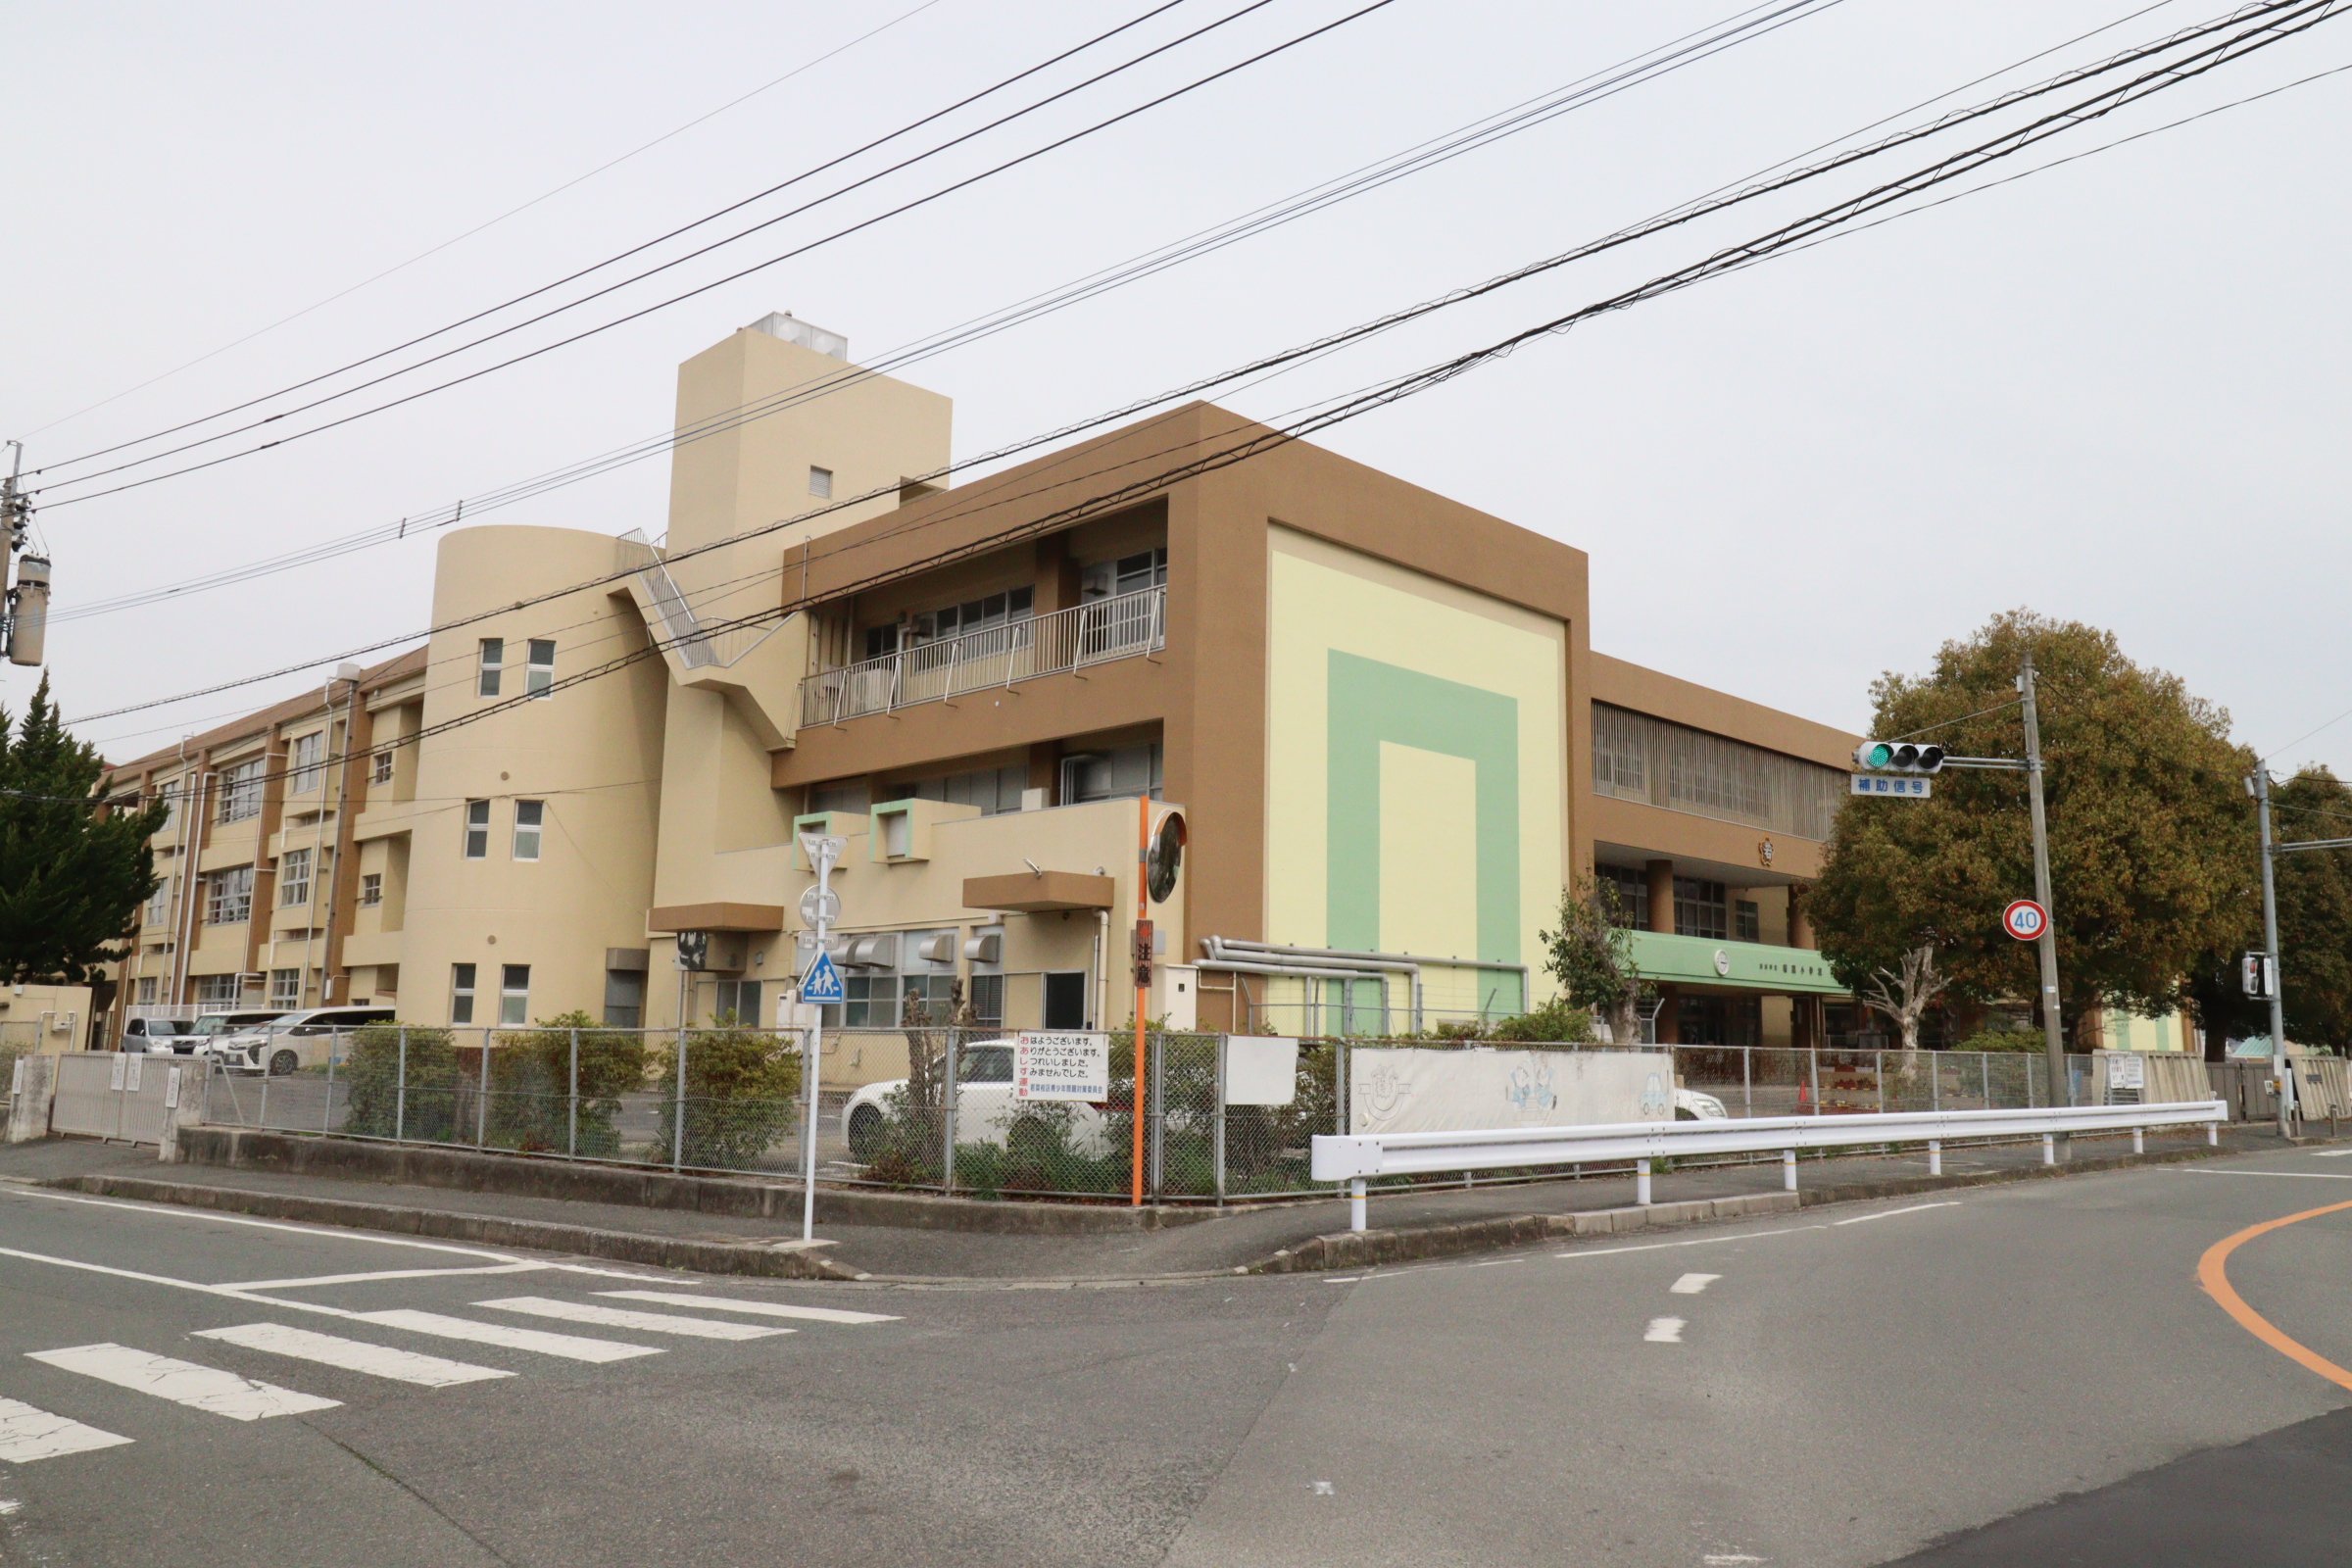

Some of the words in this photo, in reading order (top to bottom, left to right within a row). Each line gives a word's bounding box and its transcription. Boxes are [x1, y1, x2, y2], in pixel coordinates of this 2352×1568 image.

[1858, 778, 1923, 794] 補助信号
[2014, 911, 2037, 929] 40
[1137, 943, 1152, 983] 注意
